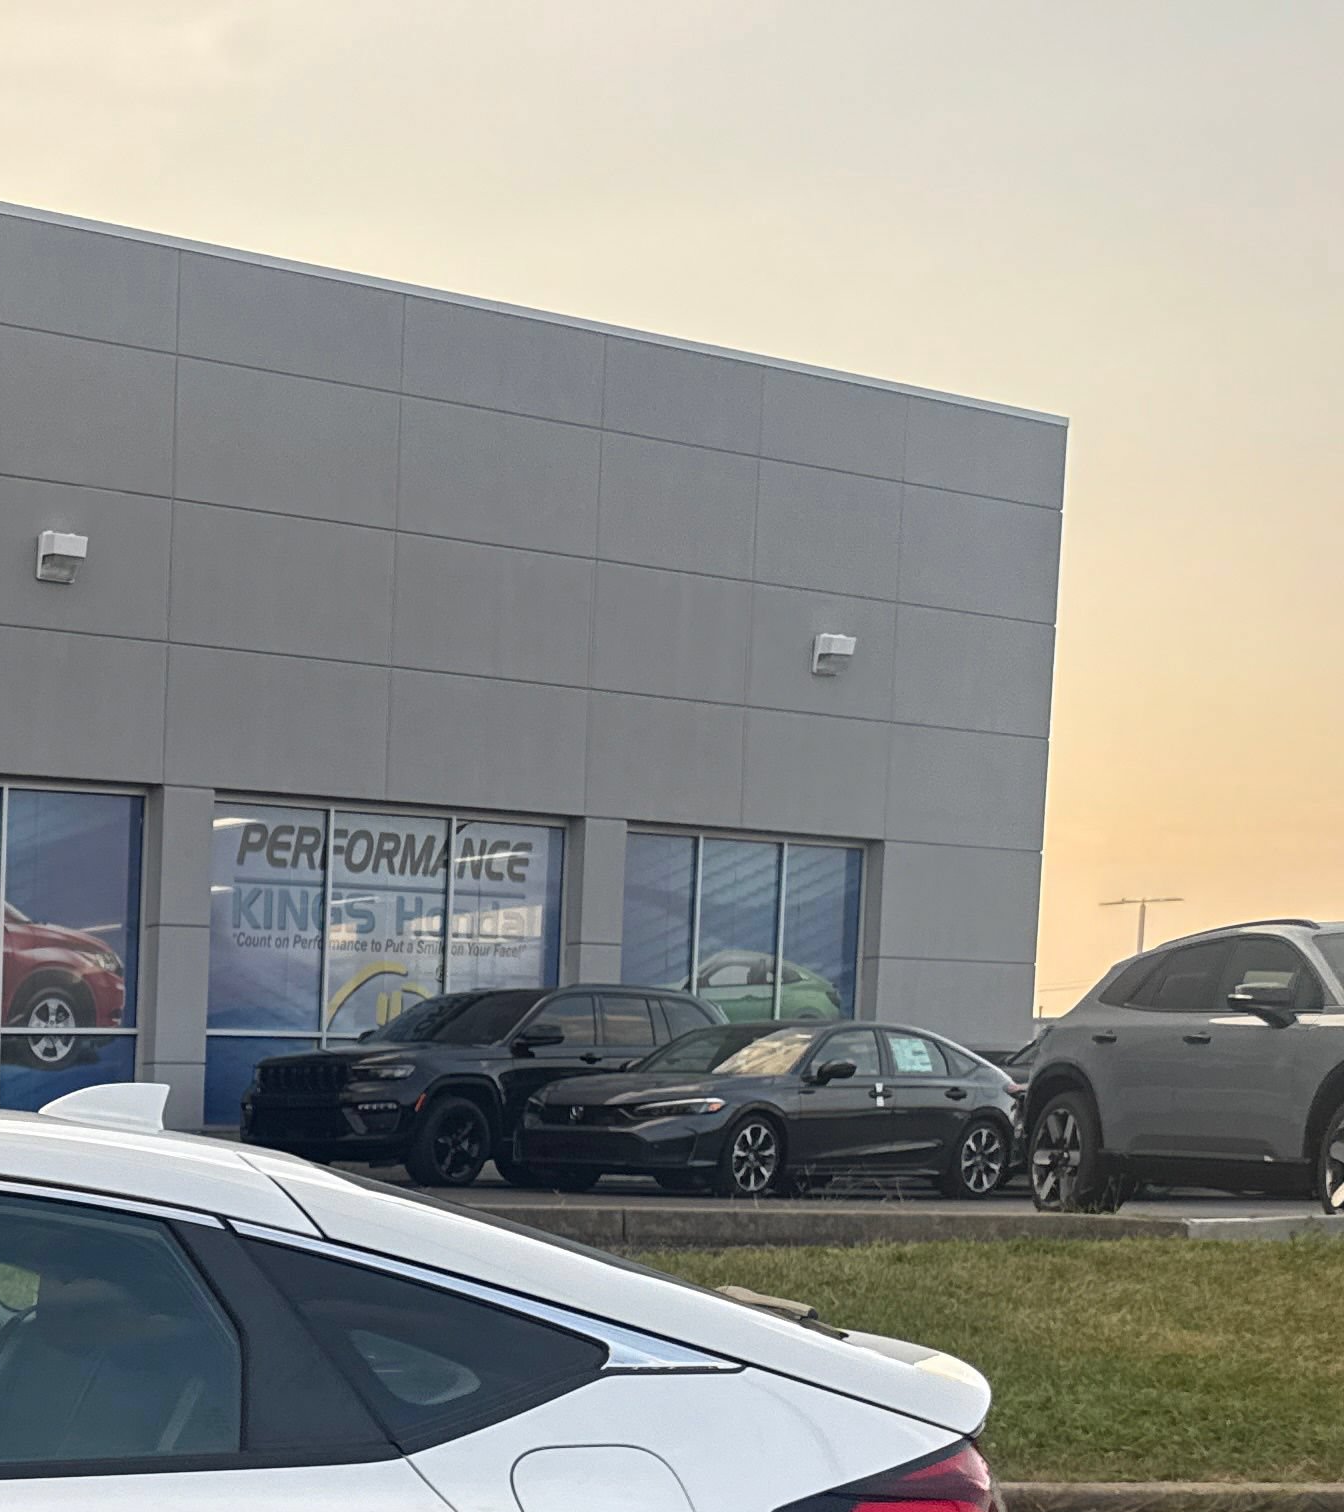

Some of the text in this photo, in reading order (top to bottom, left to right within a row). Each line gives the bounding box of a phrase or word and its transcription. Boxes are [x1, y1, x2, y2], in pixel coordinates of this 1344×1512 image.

[236, 822, 533, 883] PERFORMANCE
[232, 885, 376, 935] KINGS
[275, 937, 290, 949] on
[370, 938, 382, 953] to
[384, 938, 405, 954] Put
[406, 942, 413, 953] a
[450, 944, 464, 955] on
[466, 943, 491, 957] Your
